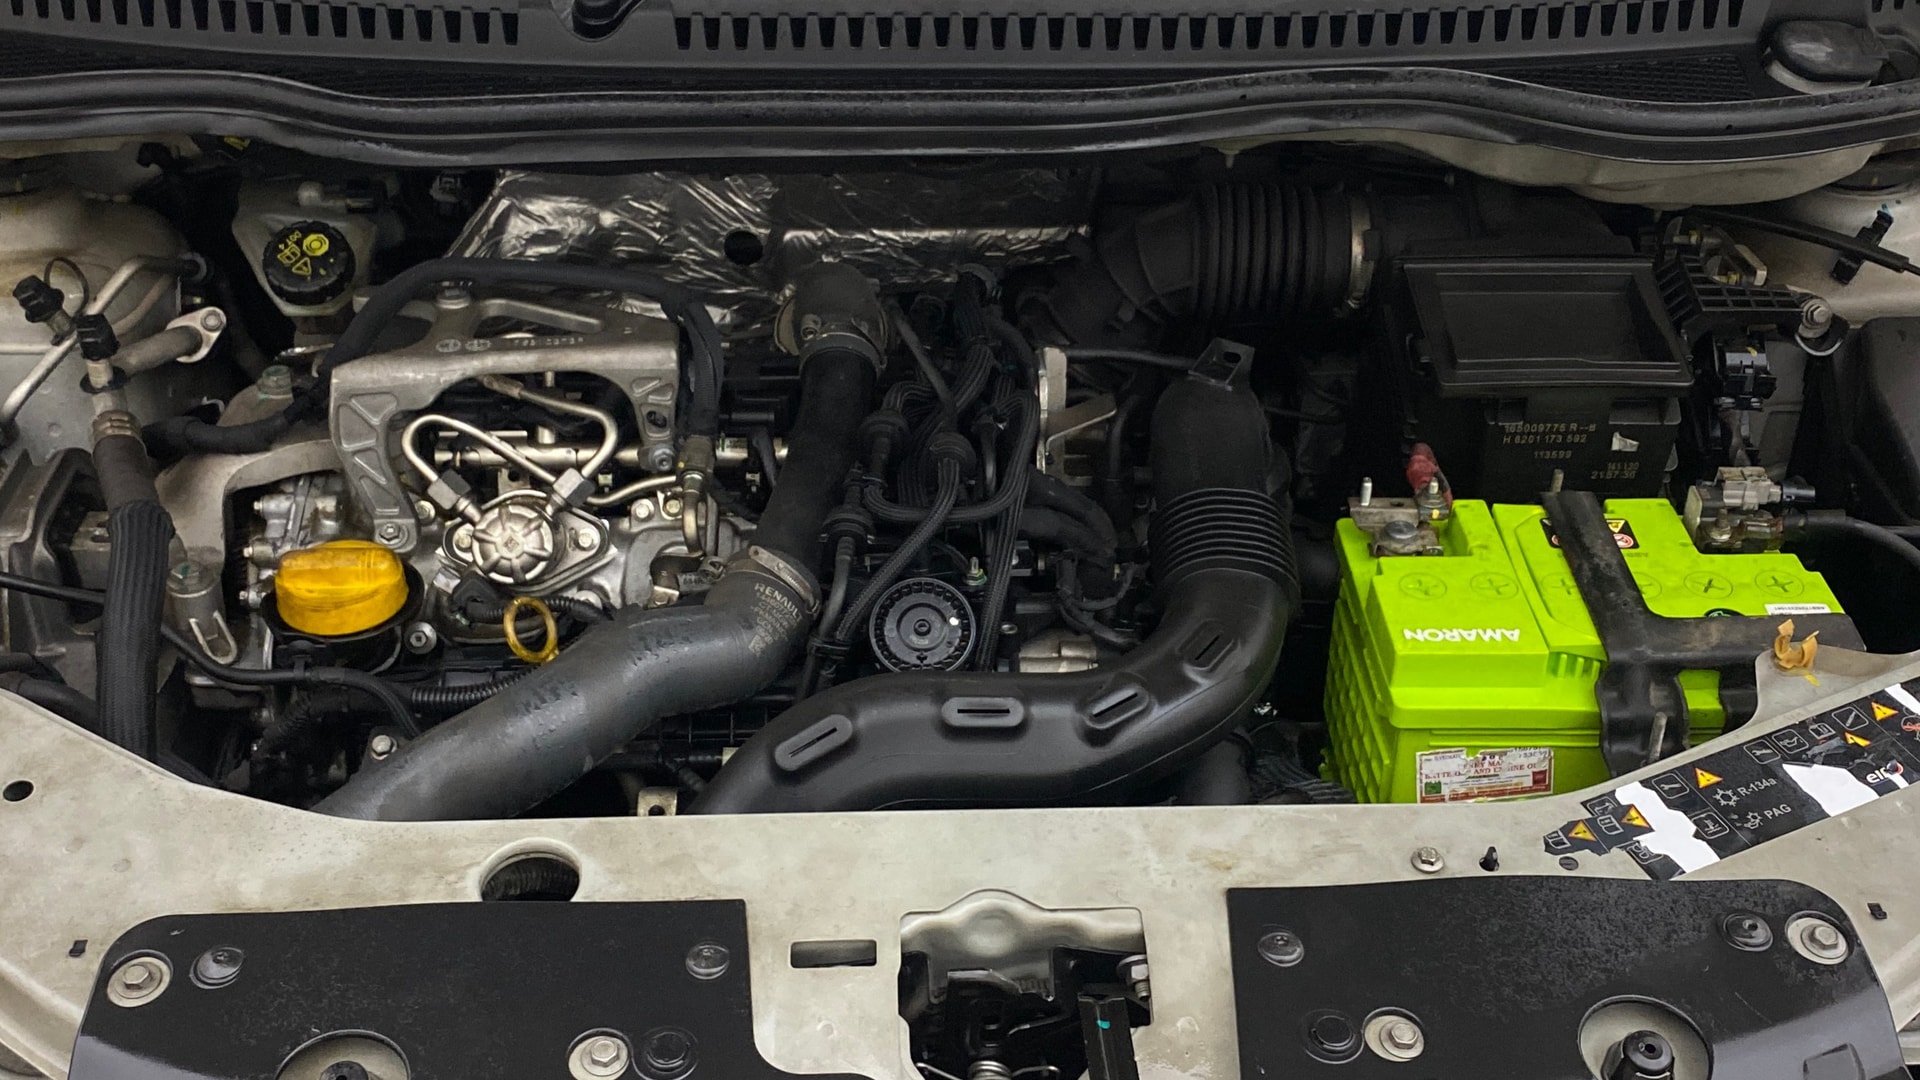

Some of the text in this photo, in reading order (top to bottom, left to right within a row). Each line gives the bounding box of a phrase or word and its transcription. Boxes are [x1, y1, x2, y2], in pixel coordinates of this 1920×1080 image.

[754, 583, 802, 622] RENAULT
[1403, 628, 1520, 642] AMARON
[1737, 776, 1778, 797] R-134a
[1764, 803, 1792, 819] PAG
